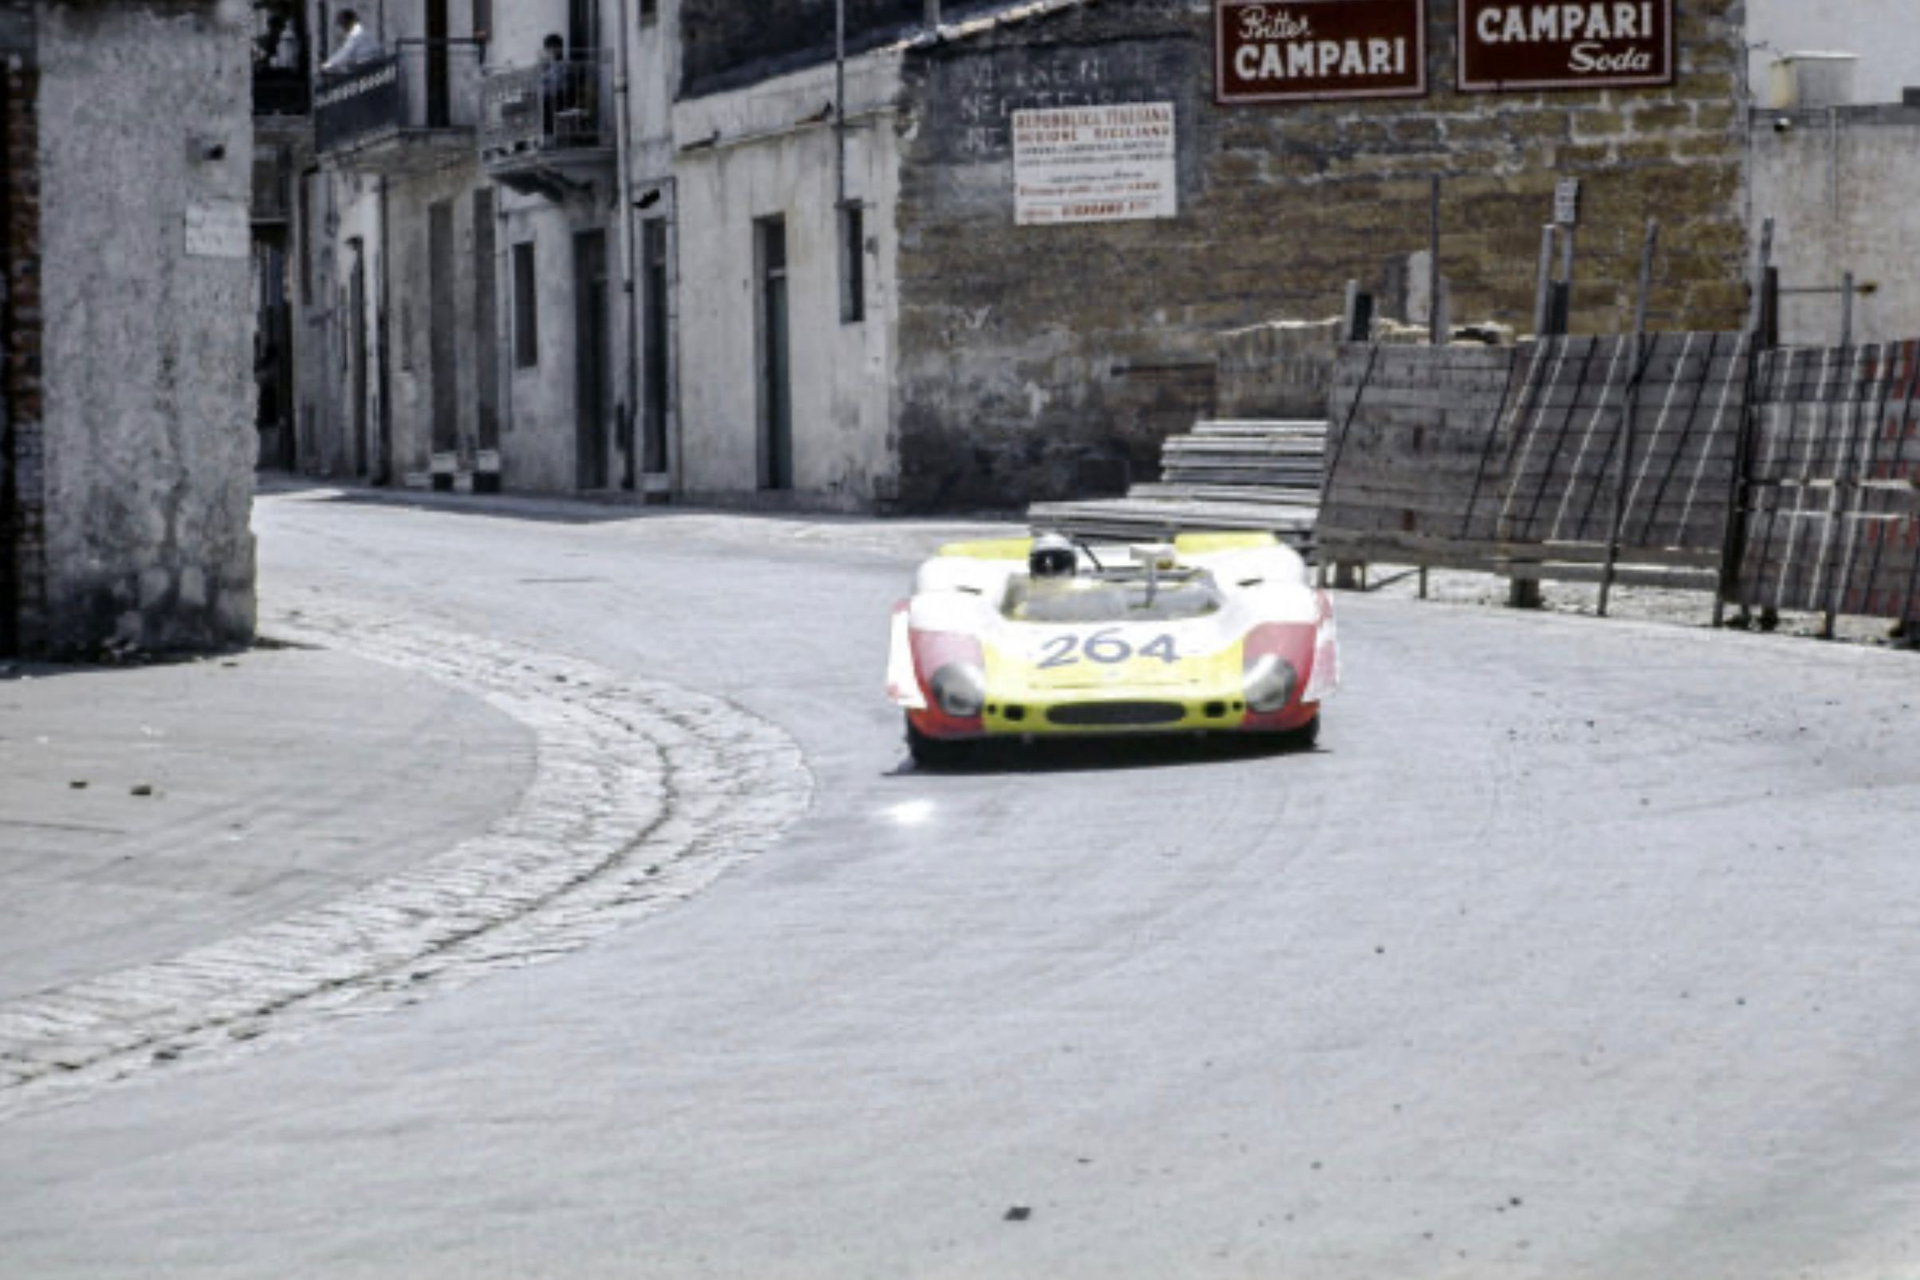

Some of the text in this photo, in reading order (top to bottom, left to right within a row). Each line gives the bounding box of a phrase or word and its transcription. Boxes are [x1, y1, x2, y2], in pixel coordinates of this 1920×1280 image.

[1238, 5, 1312, 39] Bitter
[1476, 2, 1653, 43] CAMPARI
[1235, 37, 1405, 80] CAMPARI
[1566, 42, 1652, 73] Soda
[1036, 626, 1183, 670] 264
